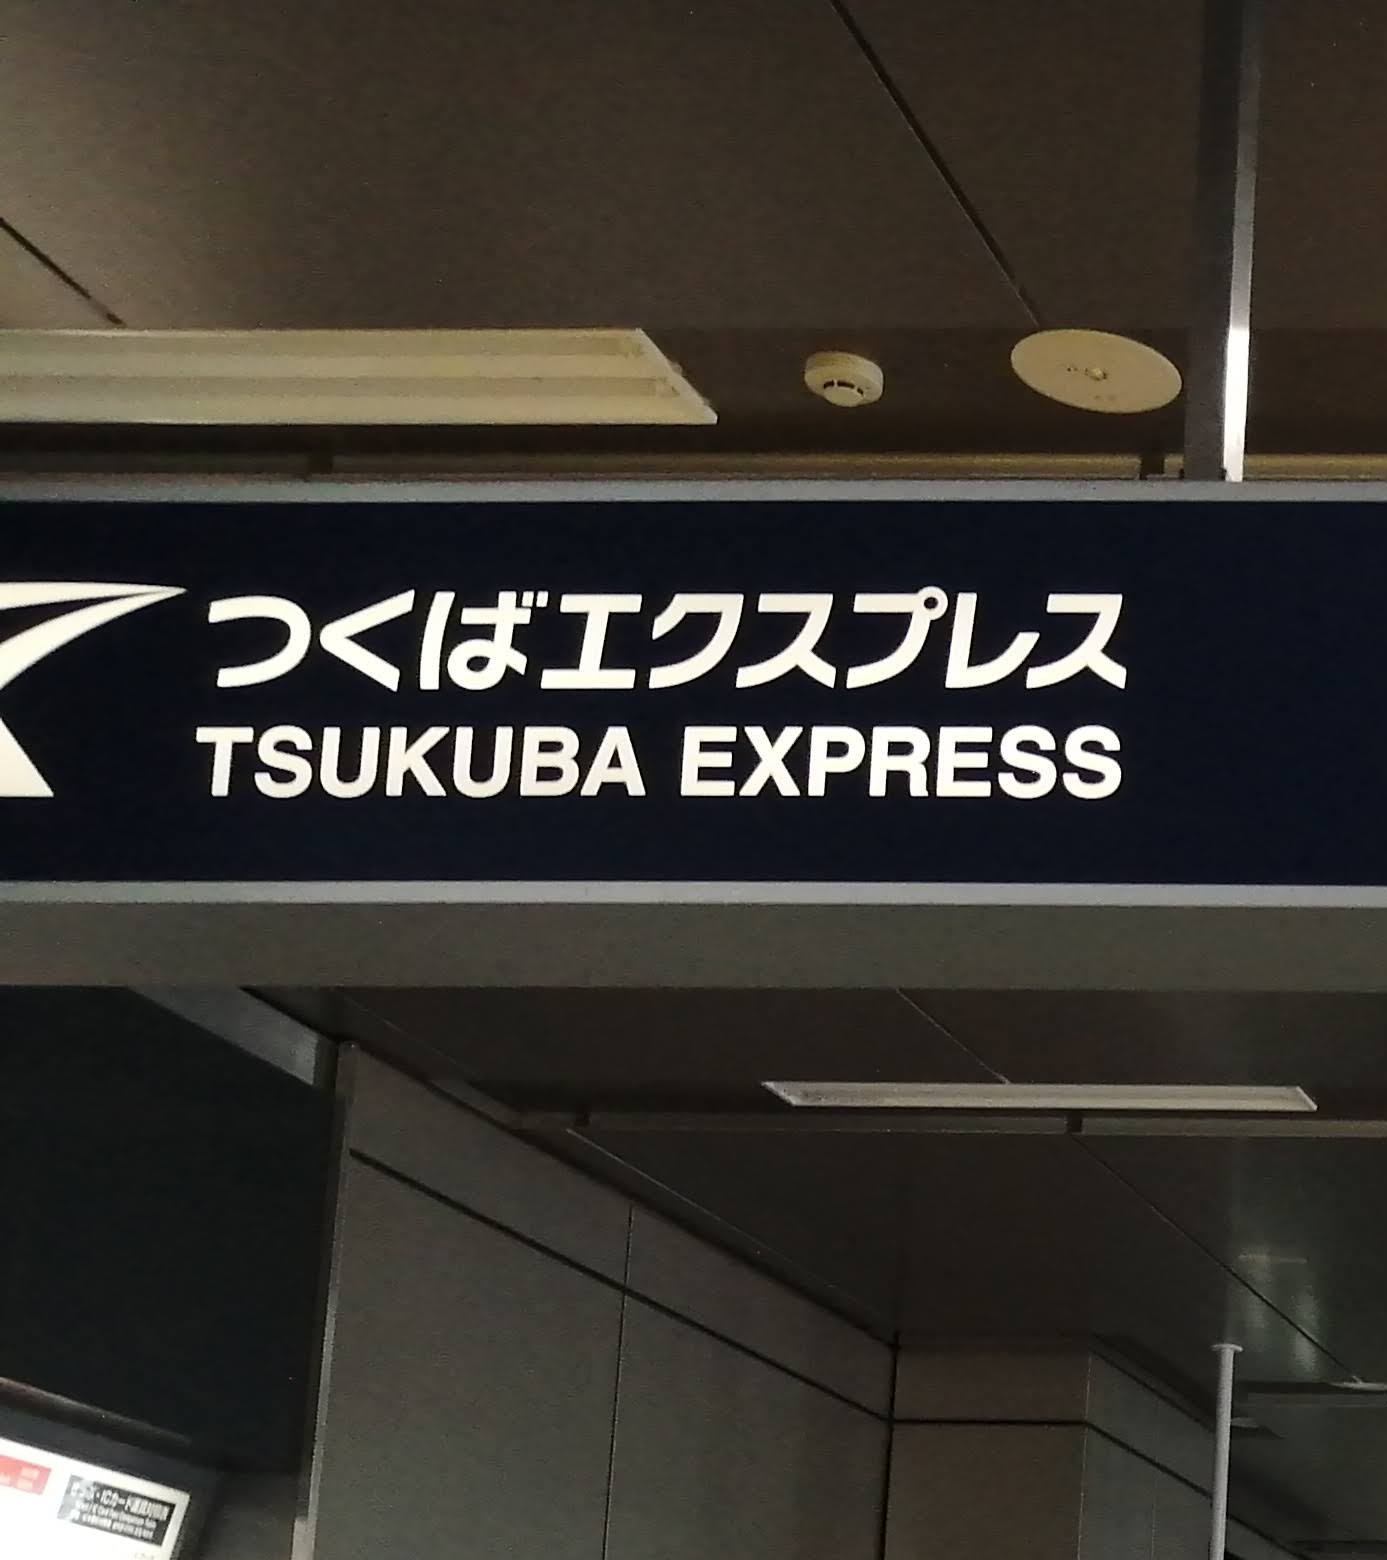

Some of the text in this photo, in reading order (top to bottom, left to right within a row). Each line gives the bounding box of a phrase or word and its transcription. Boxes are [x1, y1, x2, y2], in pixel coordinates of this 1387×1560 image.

[206, 585, 1128, 692] つくばエクスプレス
[196, 725, 1124, 800] TSUKUBA EXPRESS
